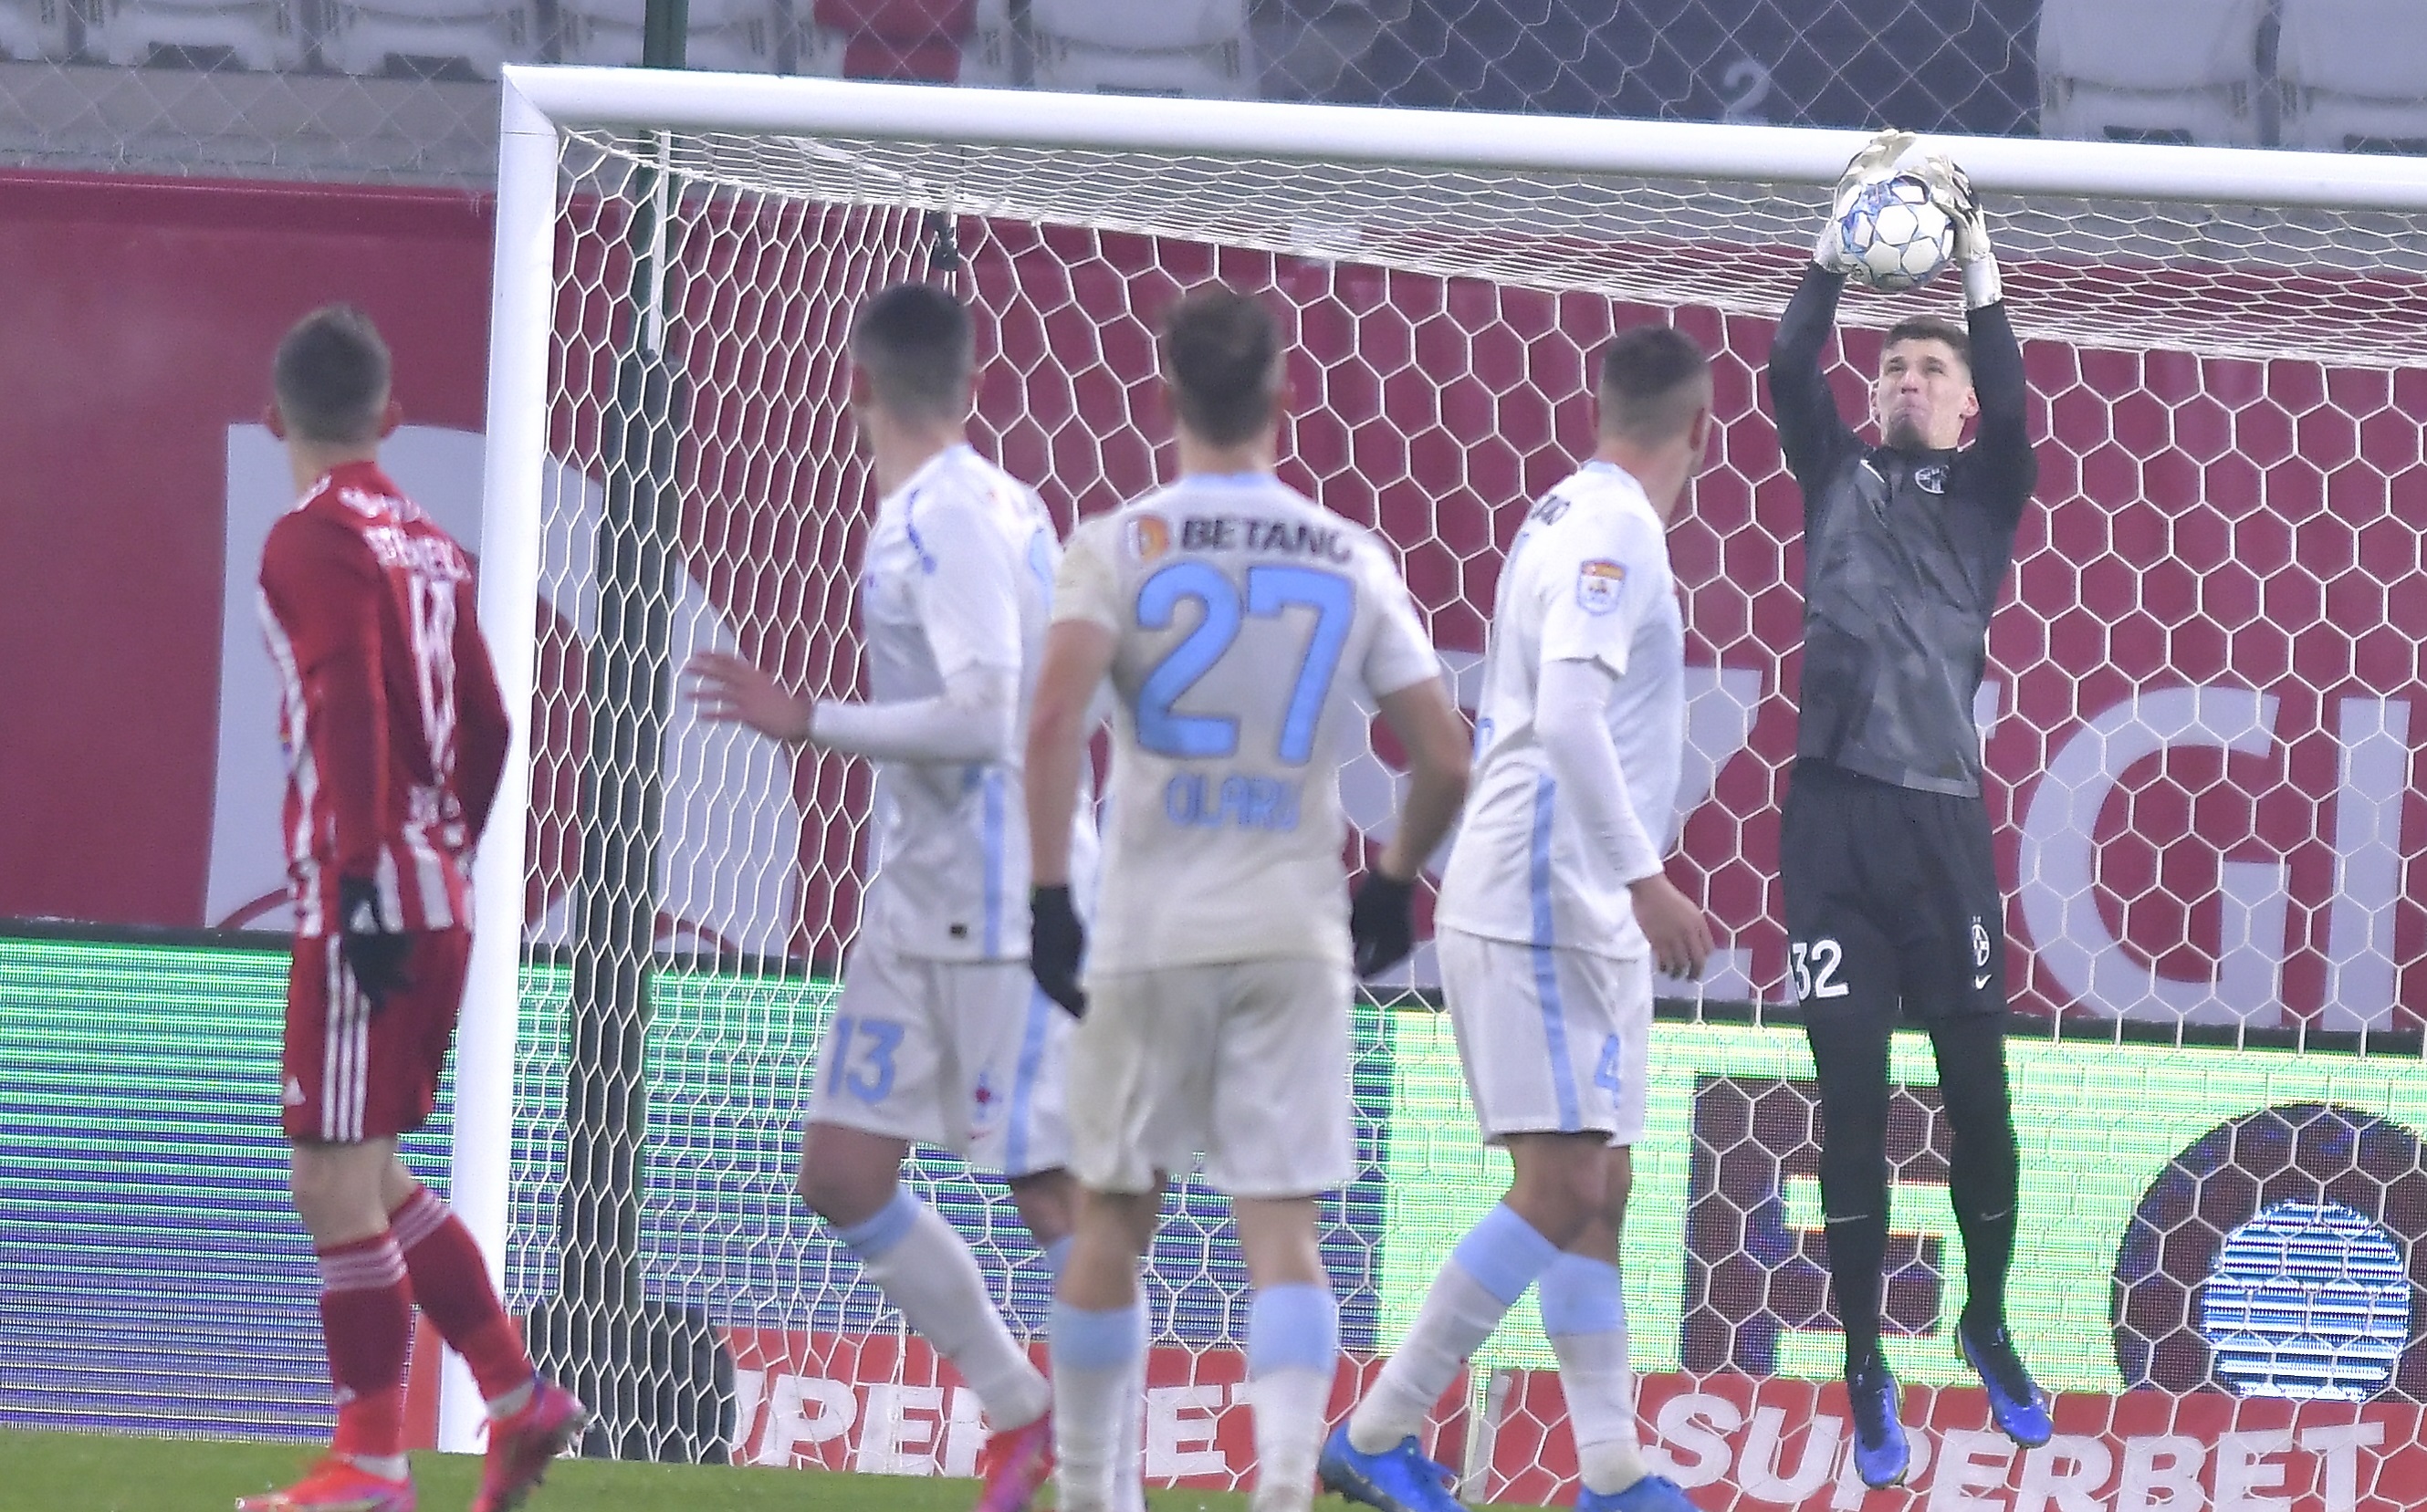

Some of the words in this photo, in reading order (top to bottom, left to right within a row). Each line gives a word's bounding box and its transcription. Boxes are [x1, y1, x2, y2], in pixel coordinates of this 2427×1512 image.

[1135, 558, 1356, 767] 27
[1791, 938, 1850, 1001] 32
[827, 1015, 905, 1104] 13
